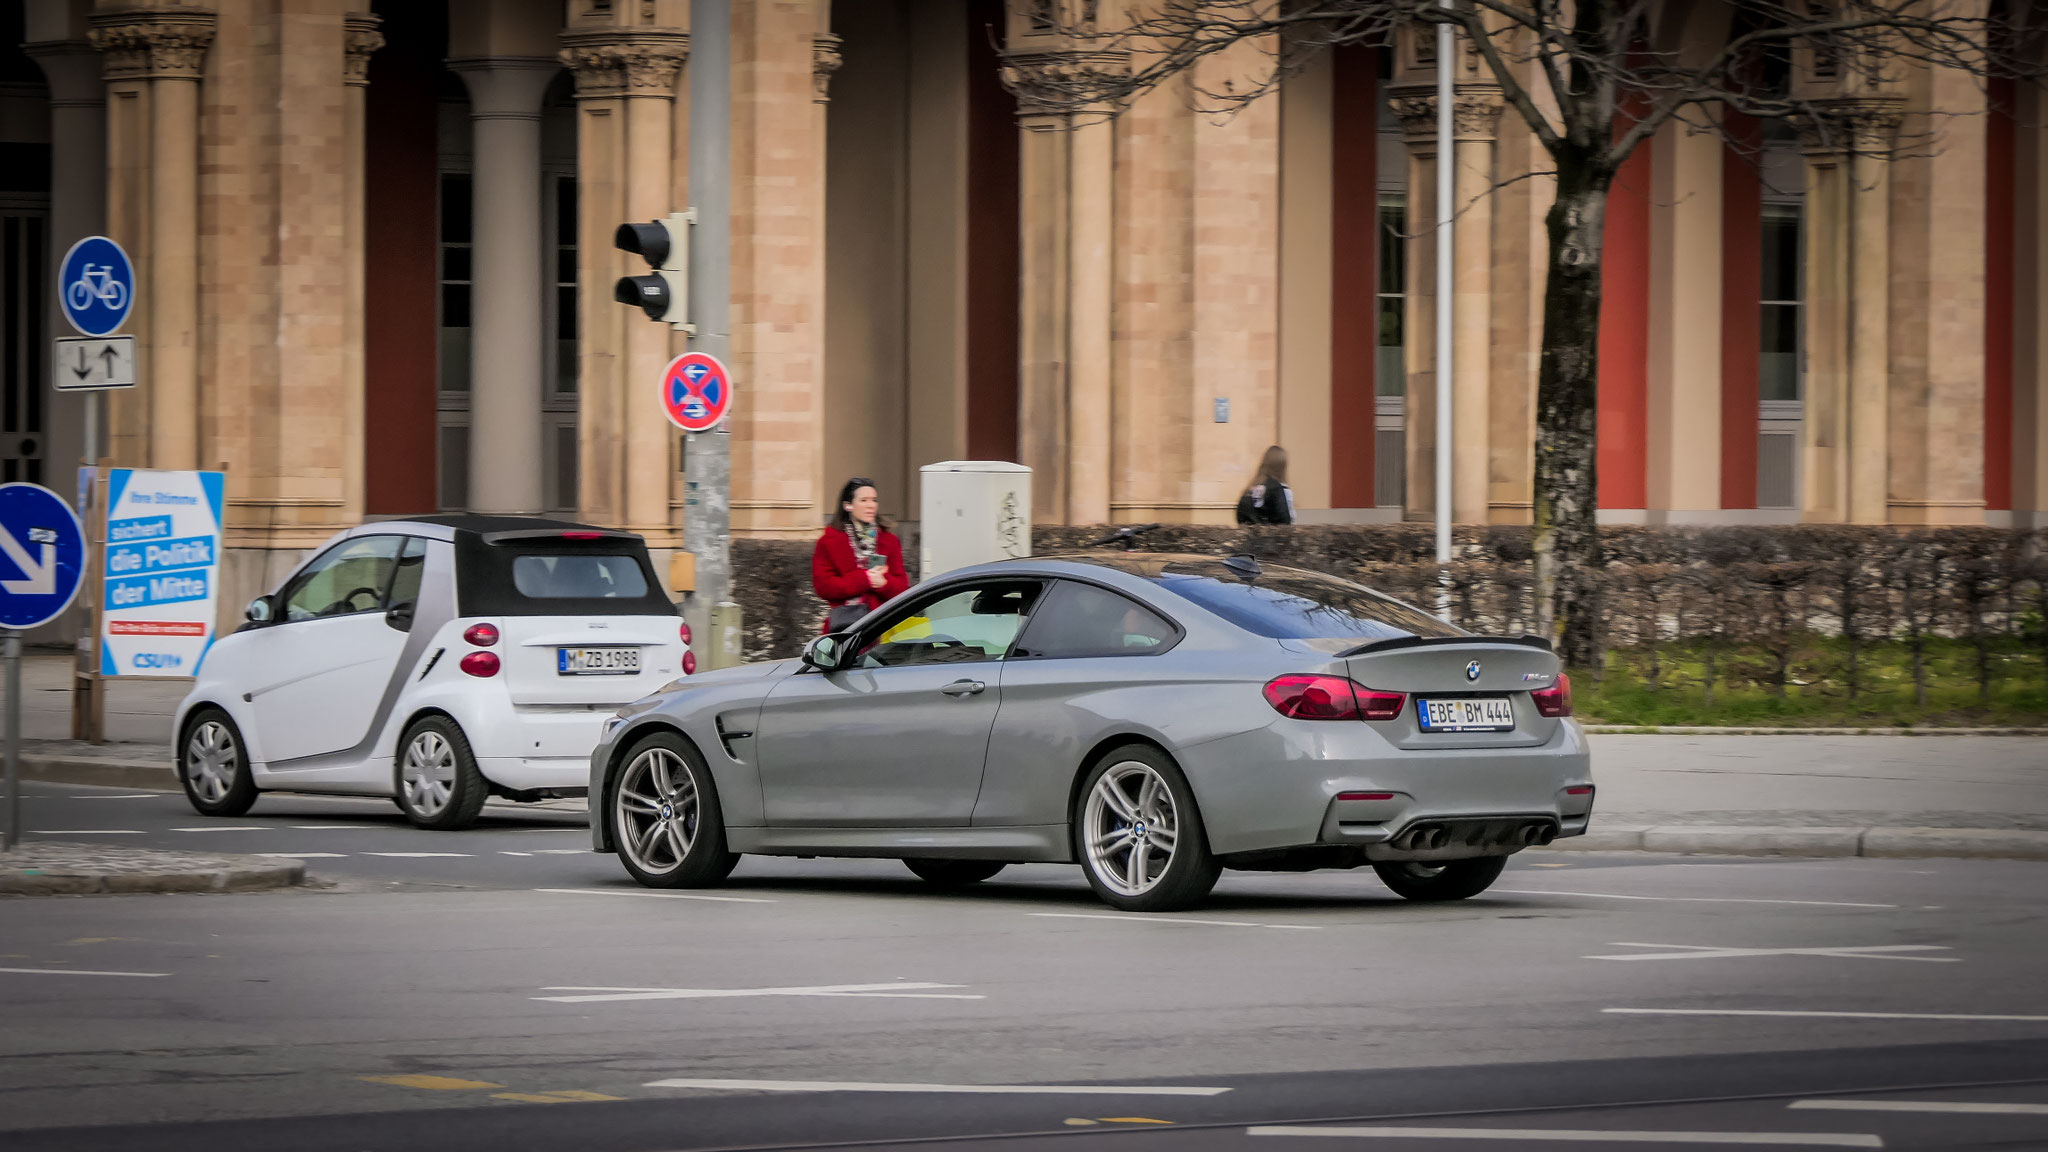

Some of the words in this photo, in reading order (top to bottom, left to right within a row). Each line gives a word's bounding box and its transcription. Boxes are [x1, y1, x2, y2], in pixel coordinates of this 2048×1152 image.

[154, 491, 198, 506] Stimme
[111, 521, 168, 540] sichert
[110, 548, 143, 572] die
[145, 541, 211, 567] Politik
[112, 582, 147, 605] der
[149, 577, 205, 600] Mitte
[586, 651, 603, 668] ZB
[606, 651, 638, 668] 1988
[1428, 703, 1457, 723] EBE
[1464, 702, 1484, 723] BM
[1487, 702, 1511, 722] 444
